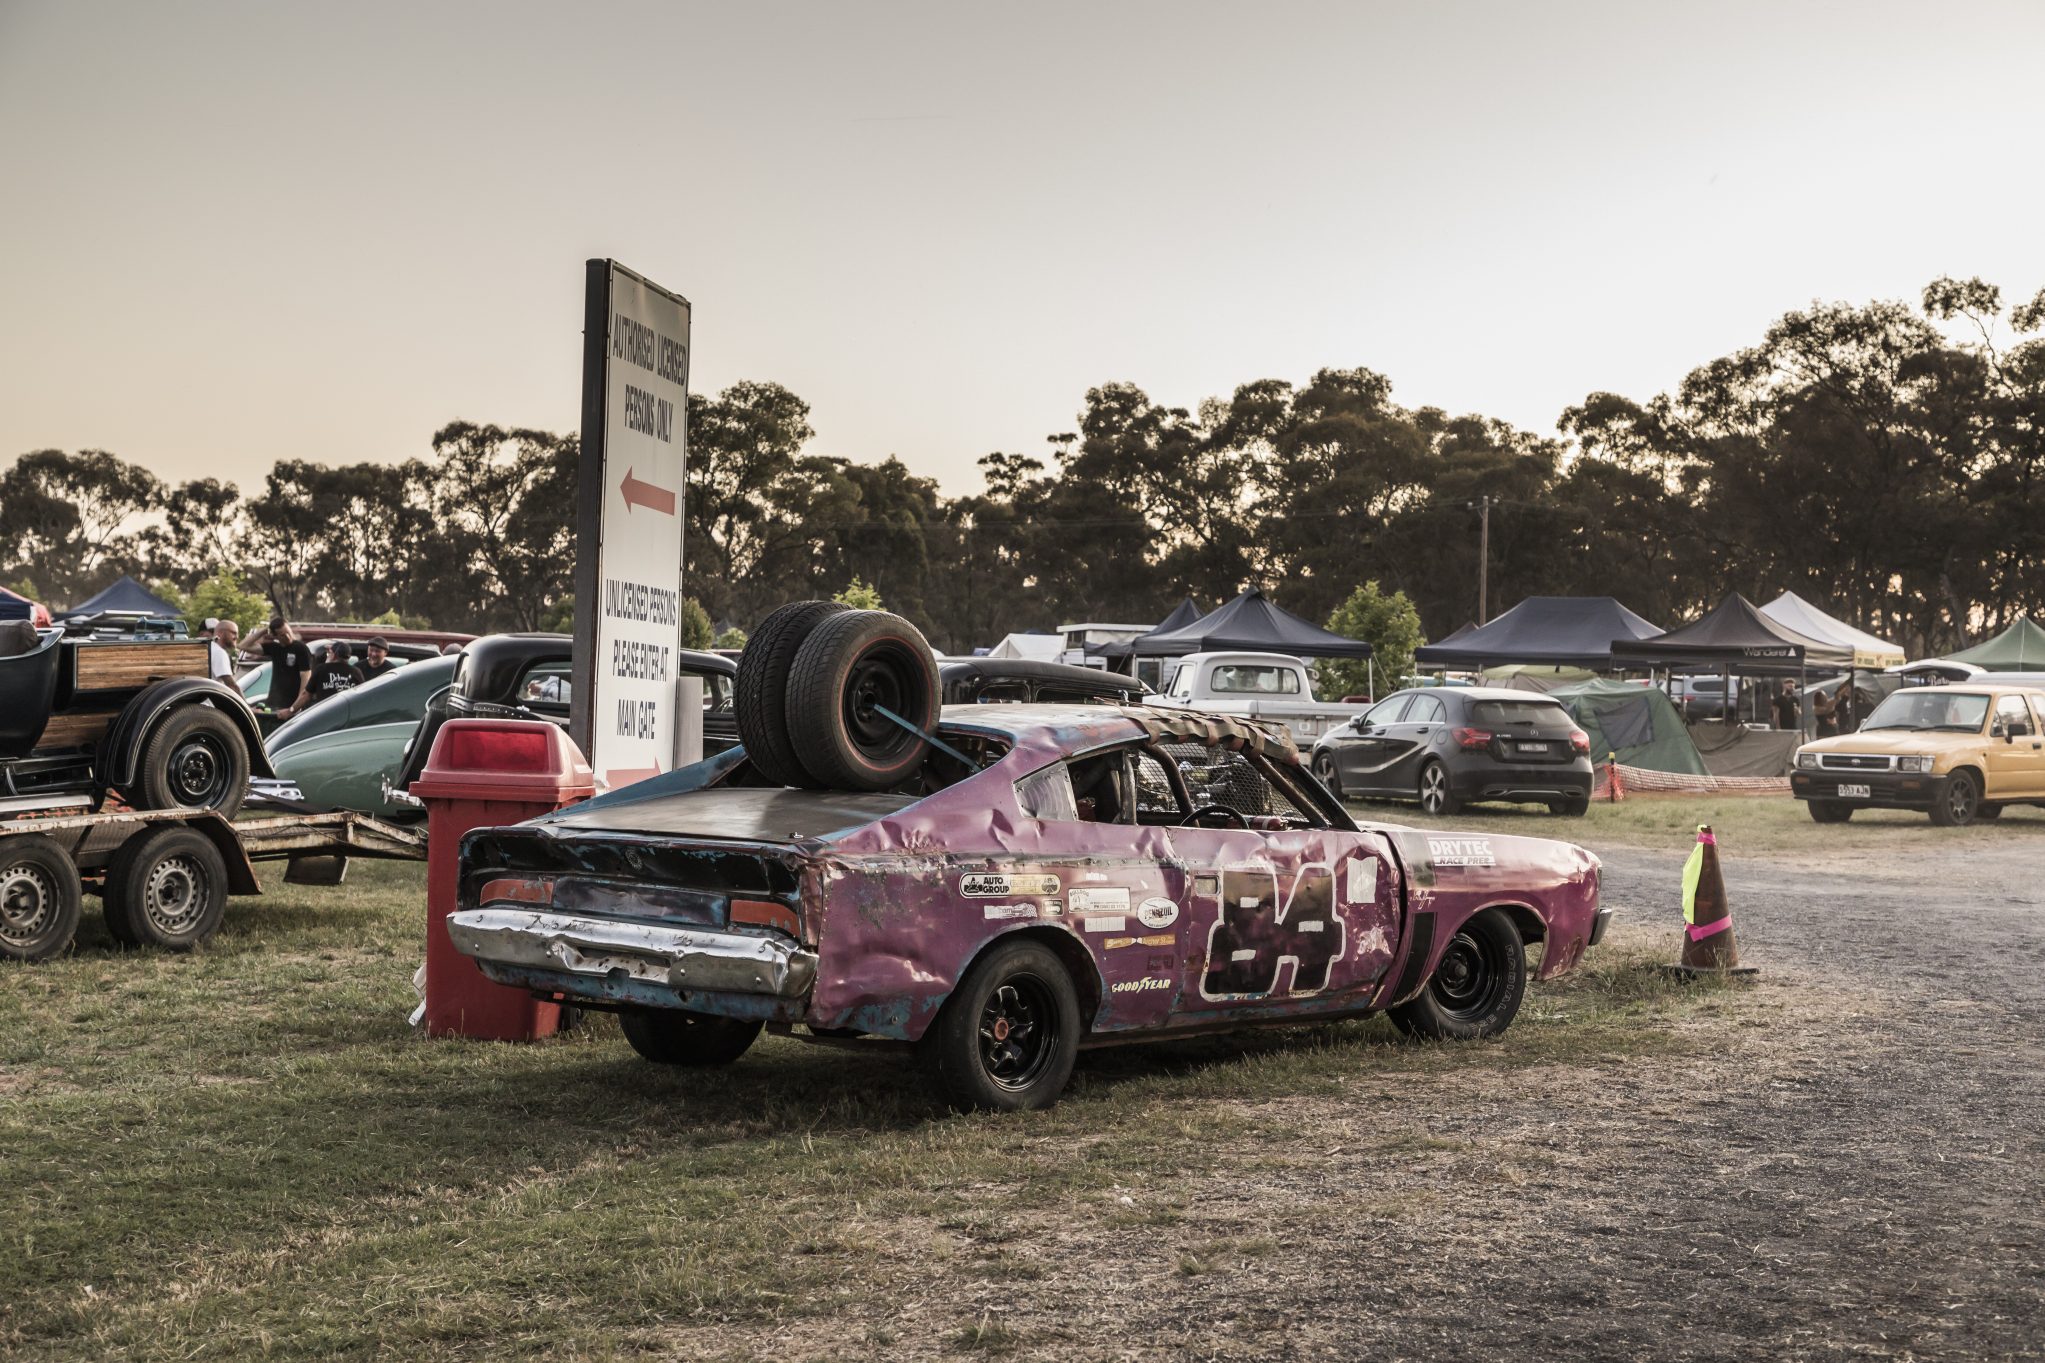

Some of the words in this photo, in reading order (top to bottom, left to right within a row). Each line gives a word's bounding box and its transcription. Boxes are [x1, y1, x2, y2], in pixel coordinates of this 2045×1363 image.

[612, 313, 655, 372] AUTHORISED
[657, 333, 686, 387] LICENSED
[624, 384, 655, 437] PERSONS
[656, 398, 674, 444] ONLY
[605, 579, 649, 622] UNLICENSED
[649, 587, 677, 626] PERSONS
[612, 639, 639, 678] PLEASE
[640, 643, 659, 681] ENTER
[660, 646, 669, 682] AT
[616, 698, 637, 737] MAIN
[638, 700, 656, 740] GATE
[1428, 840, 1494, 855] DRYTEC
[1440, 856, 1463, 865] RACE
[983, 877, 1004, 885] AUTO
[983, 885, 1010, 894] GROUP
[1111, 977, 1171, 994] GOODYEAR
